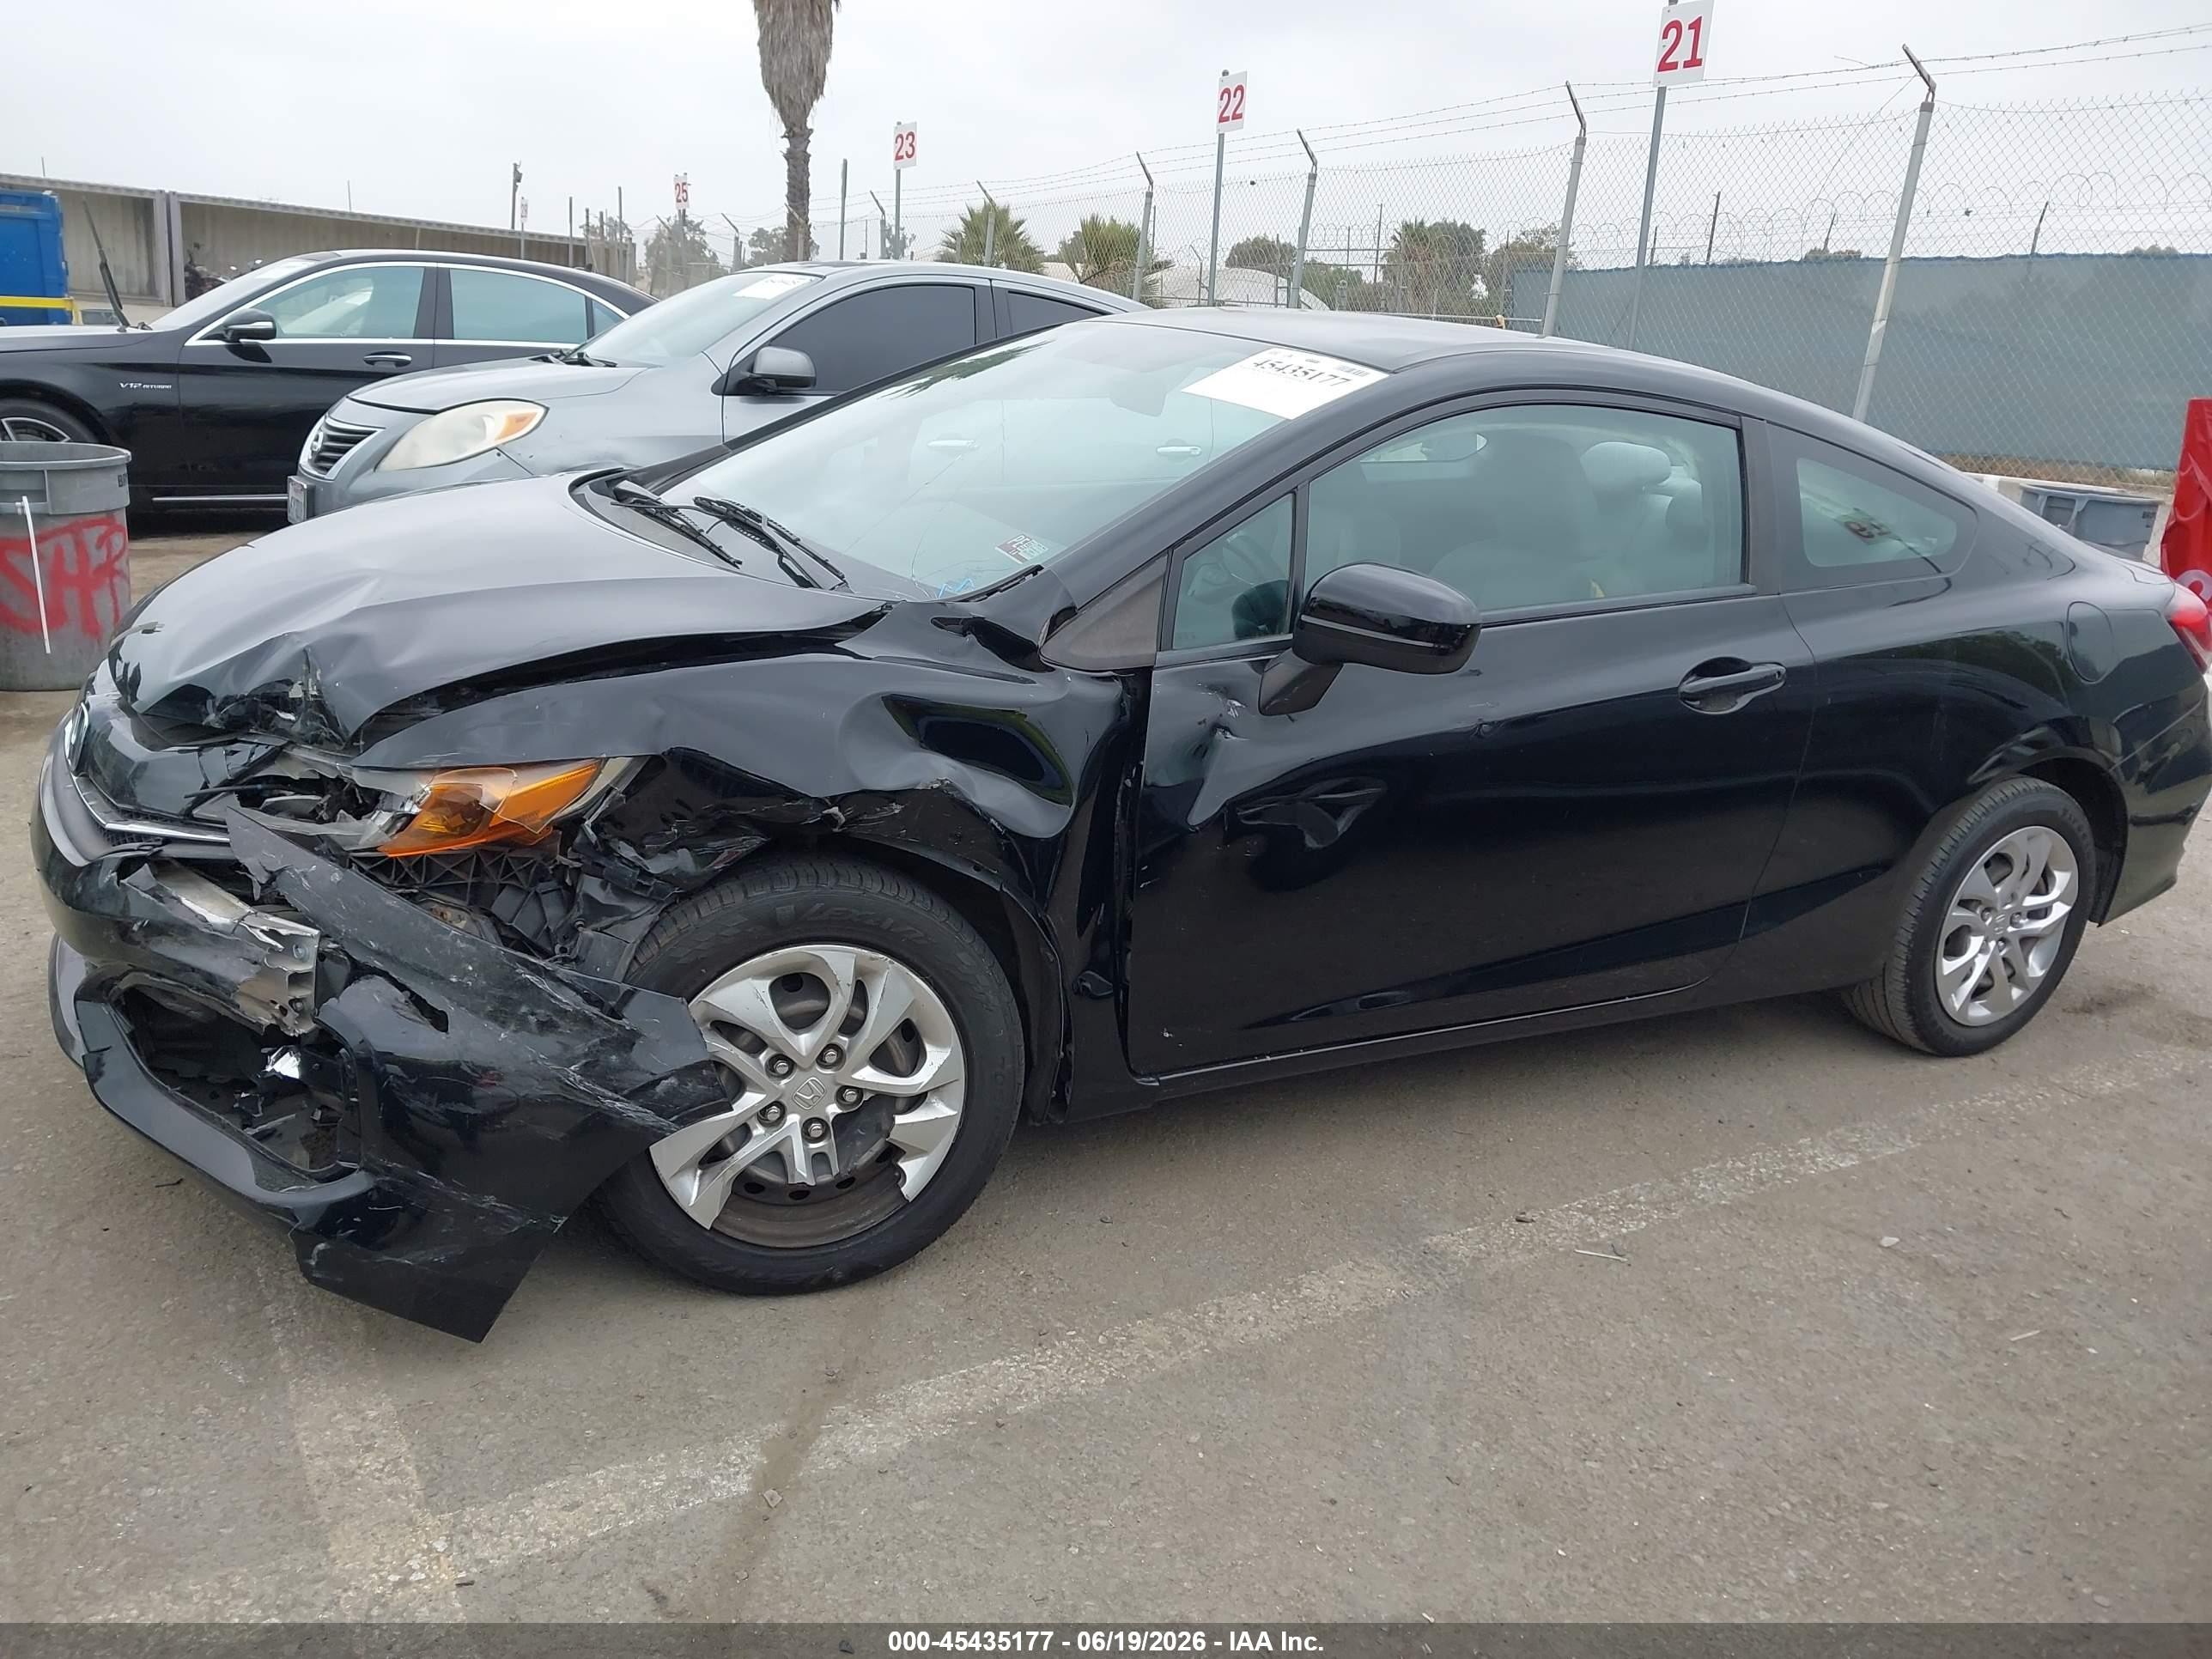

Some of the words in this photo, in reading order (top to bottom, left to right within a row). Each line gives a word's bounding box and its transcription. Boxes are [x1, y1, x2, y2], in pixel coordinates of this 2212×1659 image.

[1657, 15, 1703, 72] 21
[1218, 84, 1244, 124] 22
[895, 131, 915, 161] 23
[674, 182, 689, 203] 25
[1253, 359, 1352, 386] 45435177
